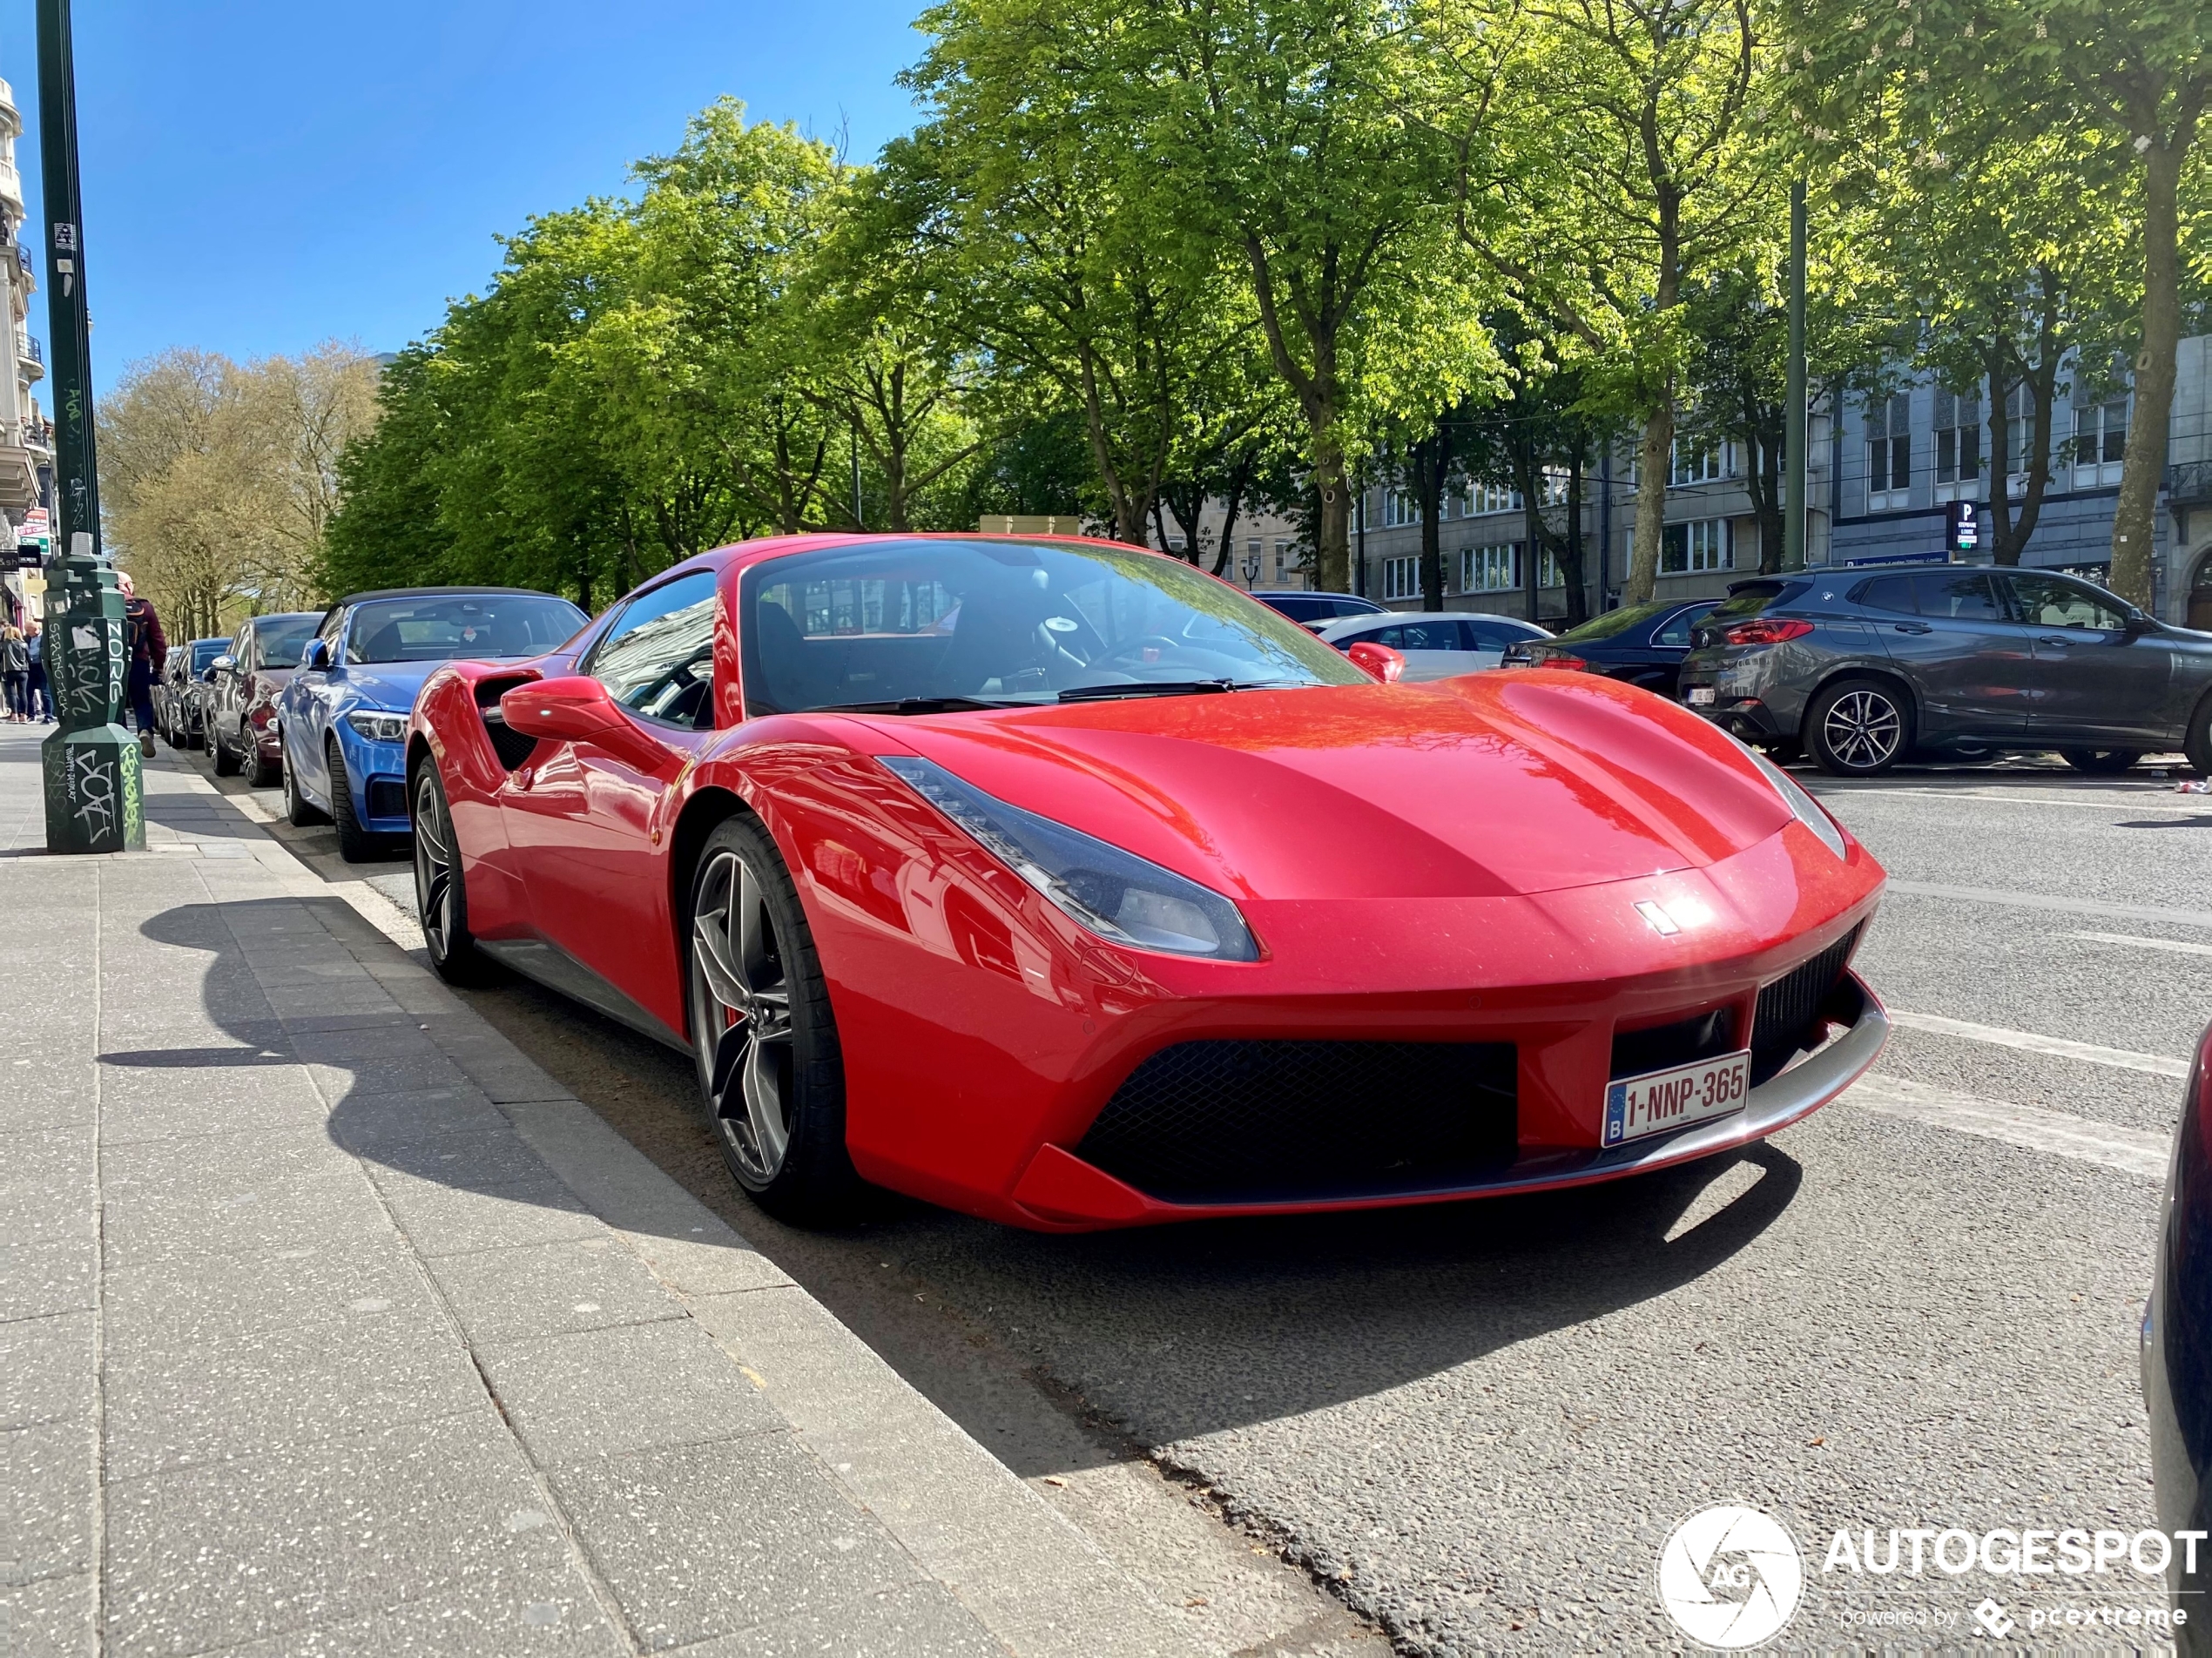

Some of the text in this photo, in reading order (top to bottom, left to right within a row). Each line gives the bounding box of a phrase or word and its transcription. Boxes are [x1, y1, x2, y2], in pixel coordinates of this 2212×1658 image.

[1964, 504, 1972, 521] P
[107, 621, 125, 704] ZORG
[1628, 1064, 1744, 1127] 1-NNP-365
[1610, 1121, 1621, 1138] B
